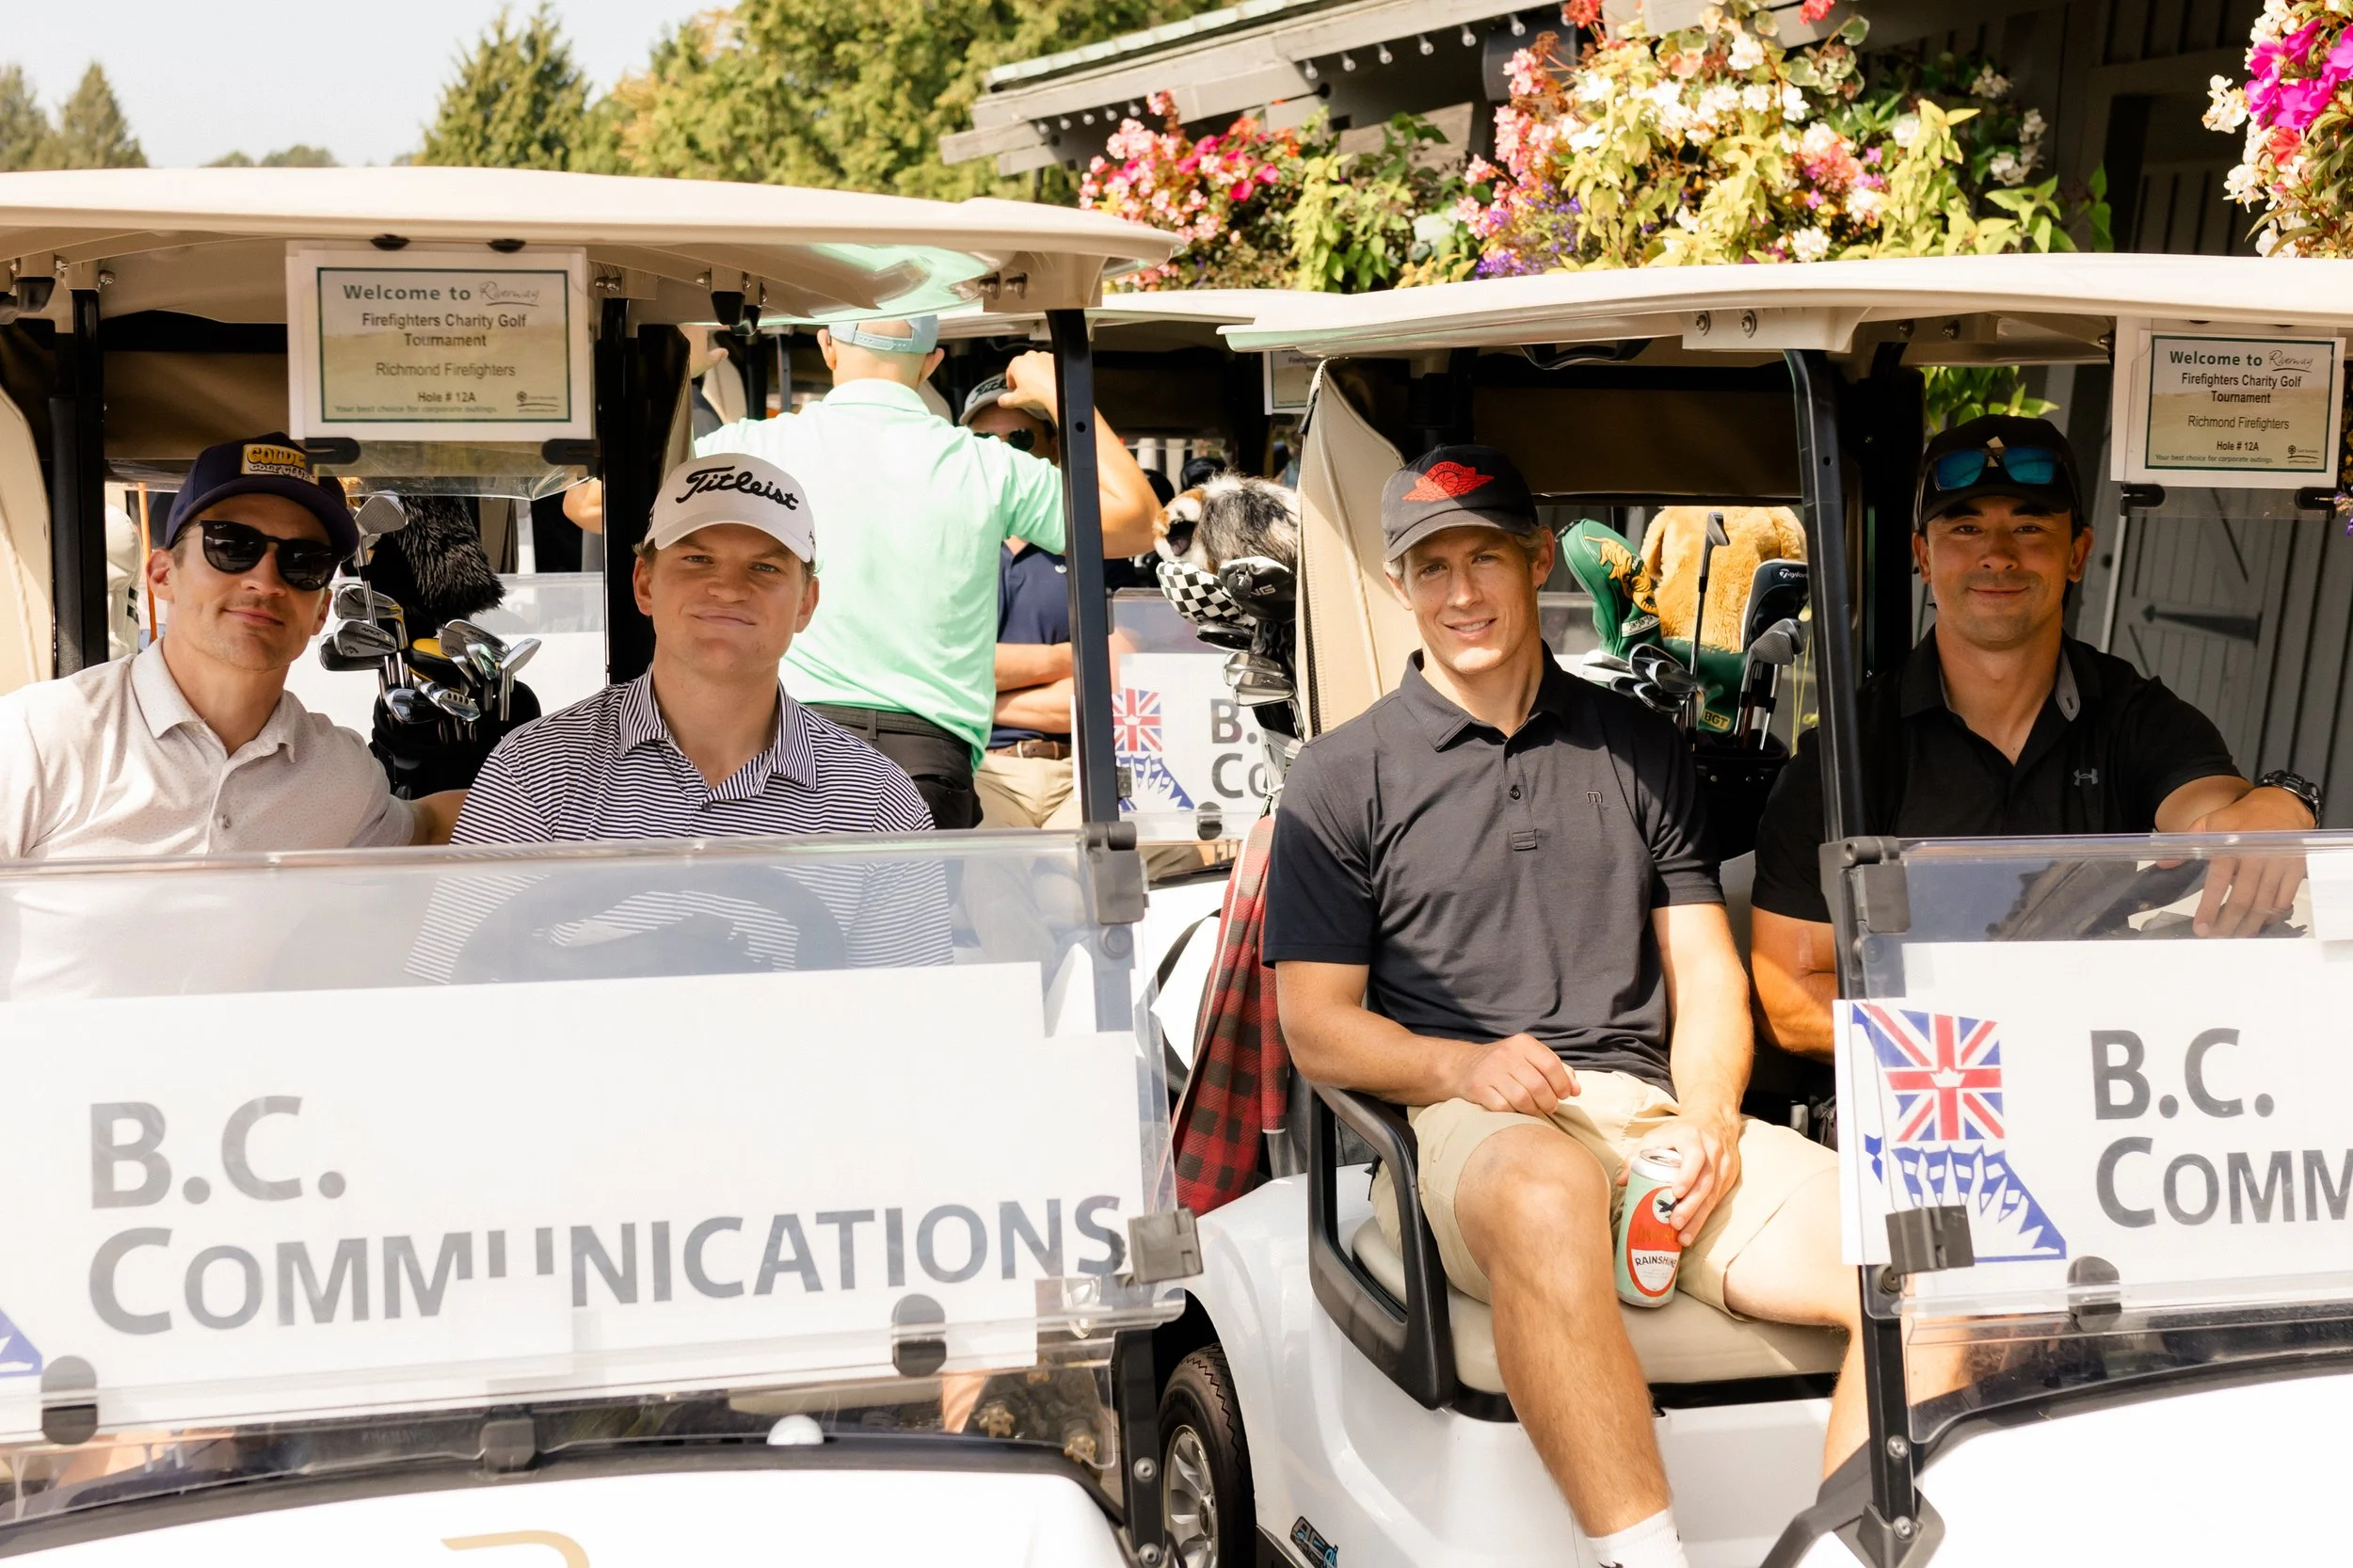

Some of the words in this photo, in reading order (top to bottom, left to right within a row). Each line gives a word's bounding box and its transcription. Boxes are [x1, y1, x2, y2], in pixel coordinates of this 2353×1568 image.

[343, 284, 440, 300] Welcome
[450, 286, 471, 300] to
[361, 312, 440, 329] Firefighters
[445, 313, 493, 329] Charity
[498, 313, 527, 328] Golf
[404, 332, 487, 346] Tournament
[2169, 351, 2240, 365] Welcome
[2247, 354, 2263, 366] to
[376, 362, 440, 376] Richmond
[444, 362, 516, 379] Firefighters
[2182, 372, 2239, 388] Firefighters
[2242, 374, 2278, 390] Charity
[2281, 376, 2302, 388] Golf
[417, 392, 442, 403] Hole
[445, 392, 452, 403] #
[456, 392, 476, 403] 12A
[2211, 391, 2271, 404] Tournament
[2188, 415, 2235, 428] Richmond
[2238, 416, 2290, 432] Firefighters
[2216, 440, 2234, 451] Hole
[2236, 441, 2242, 451] #
[2245, 442, 2259, 452] 12A
[248, 447, 305, 469] GOLDE
[675, 465, 799, 511] Titleist
[1705, 711, 1728, 728] BGT
[2090, 1027, 2274, 1120] B.C.
[90, 1095, 346, 1209] B.C.
